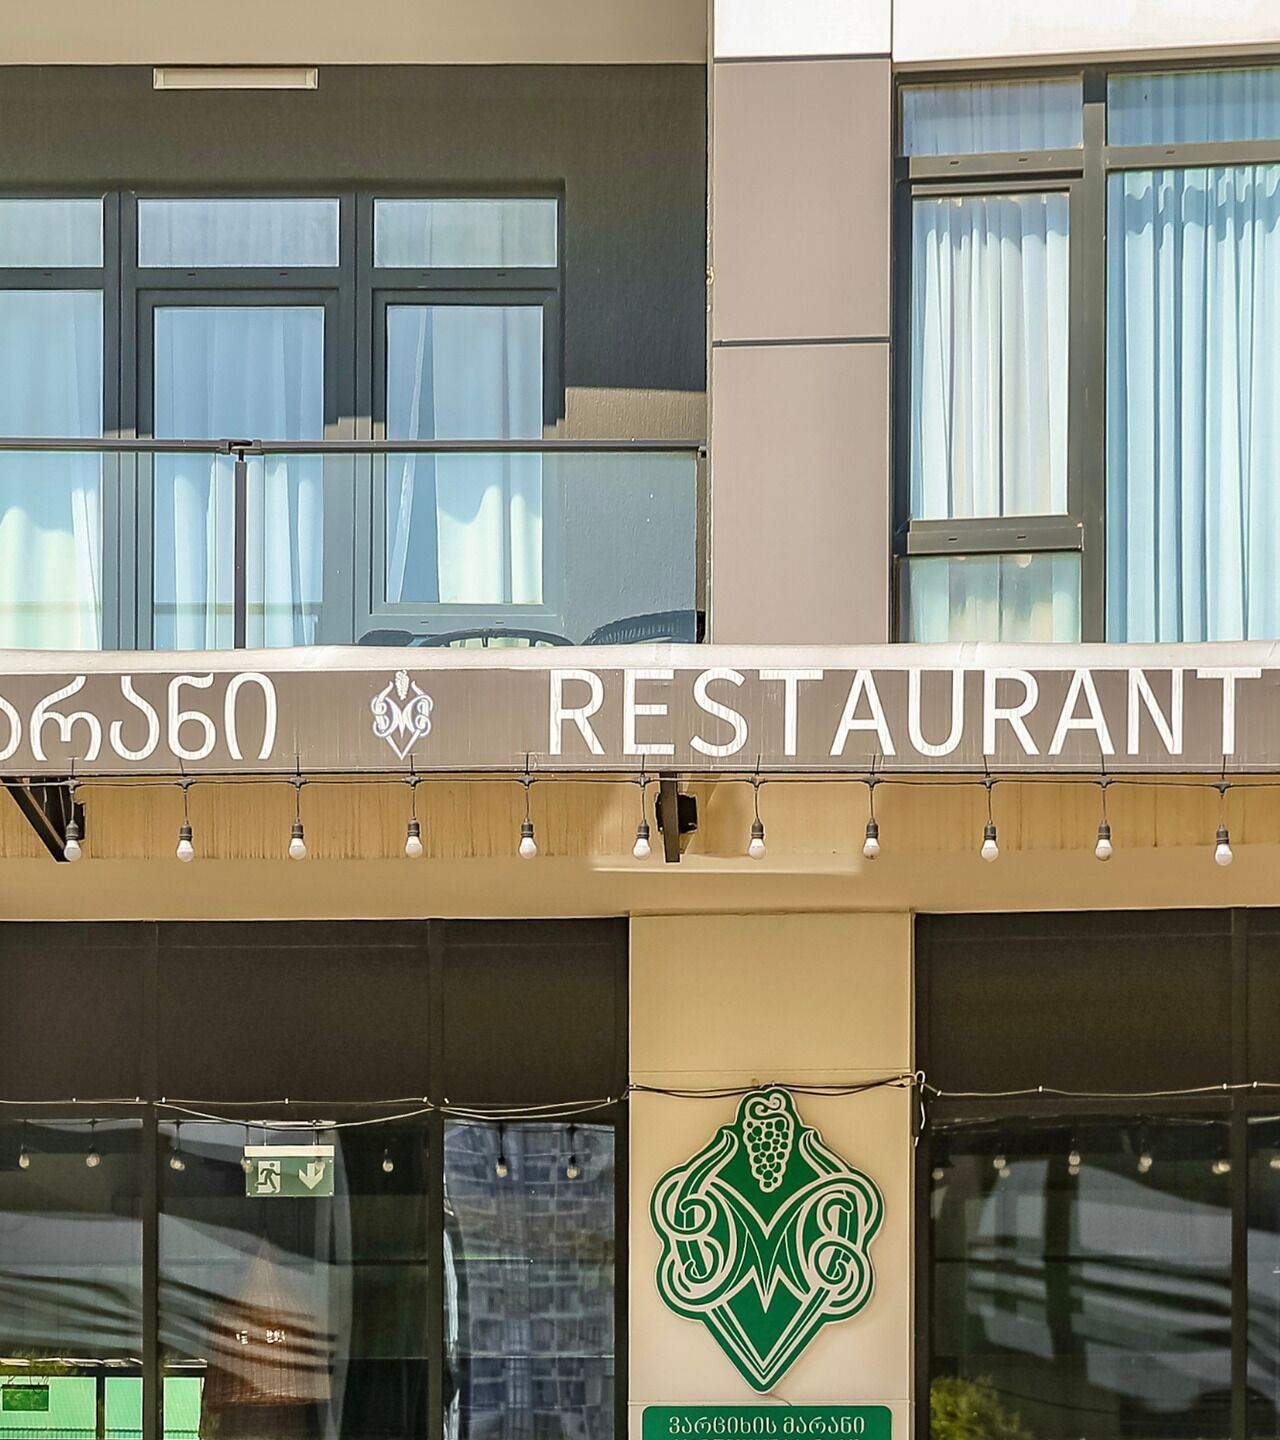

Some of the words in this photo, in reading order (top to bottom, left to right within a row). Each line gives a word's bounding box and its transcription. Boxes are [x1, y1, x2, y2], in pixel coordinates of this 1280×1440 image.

[547, 667, 1263, 757] RESTAURANT
[669, 1416, 777, 1434] ვარციხის
[783, 1416, 865, 1434] მარანი
